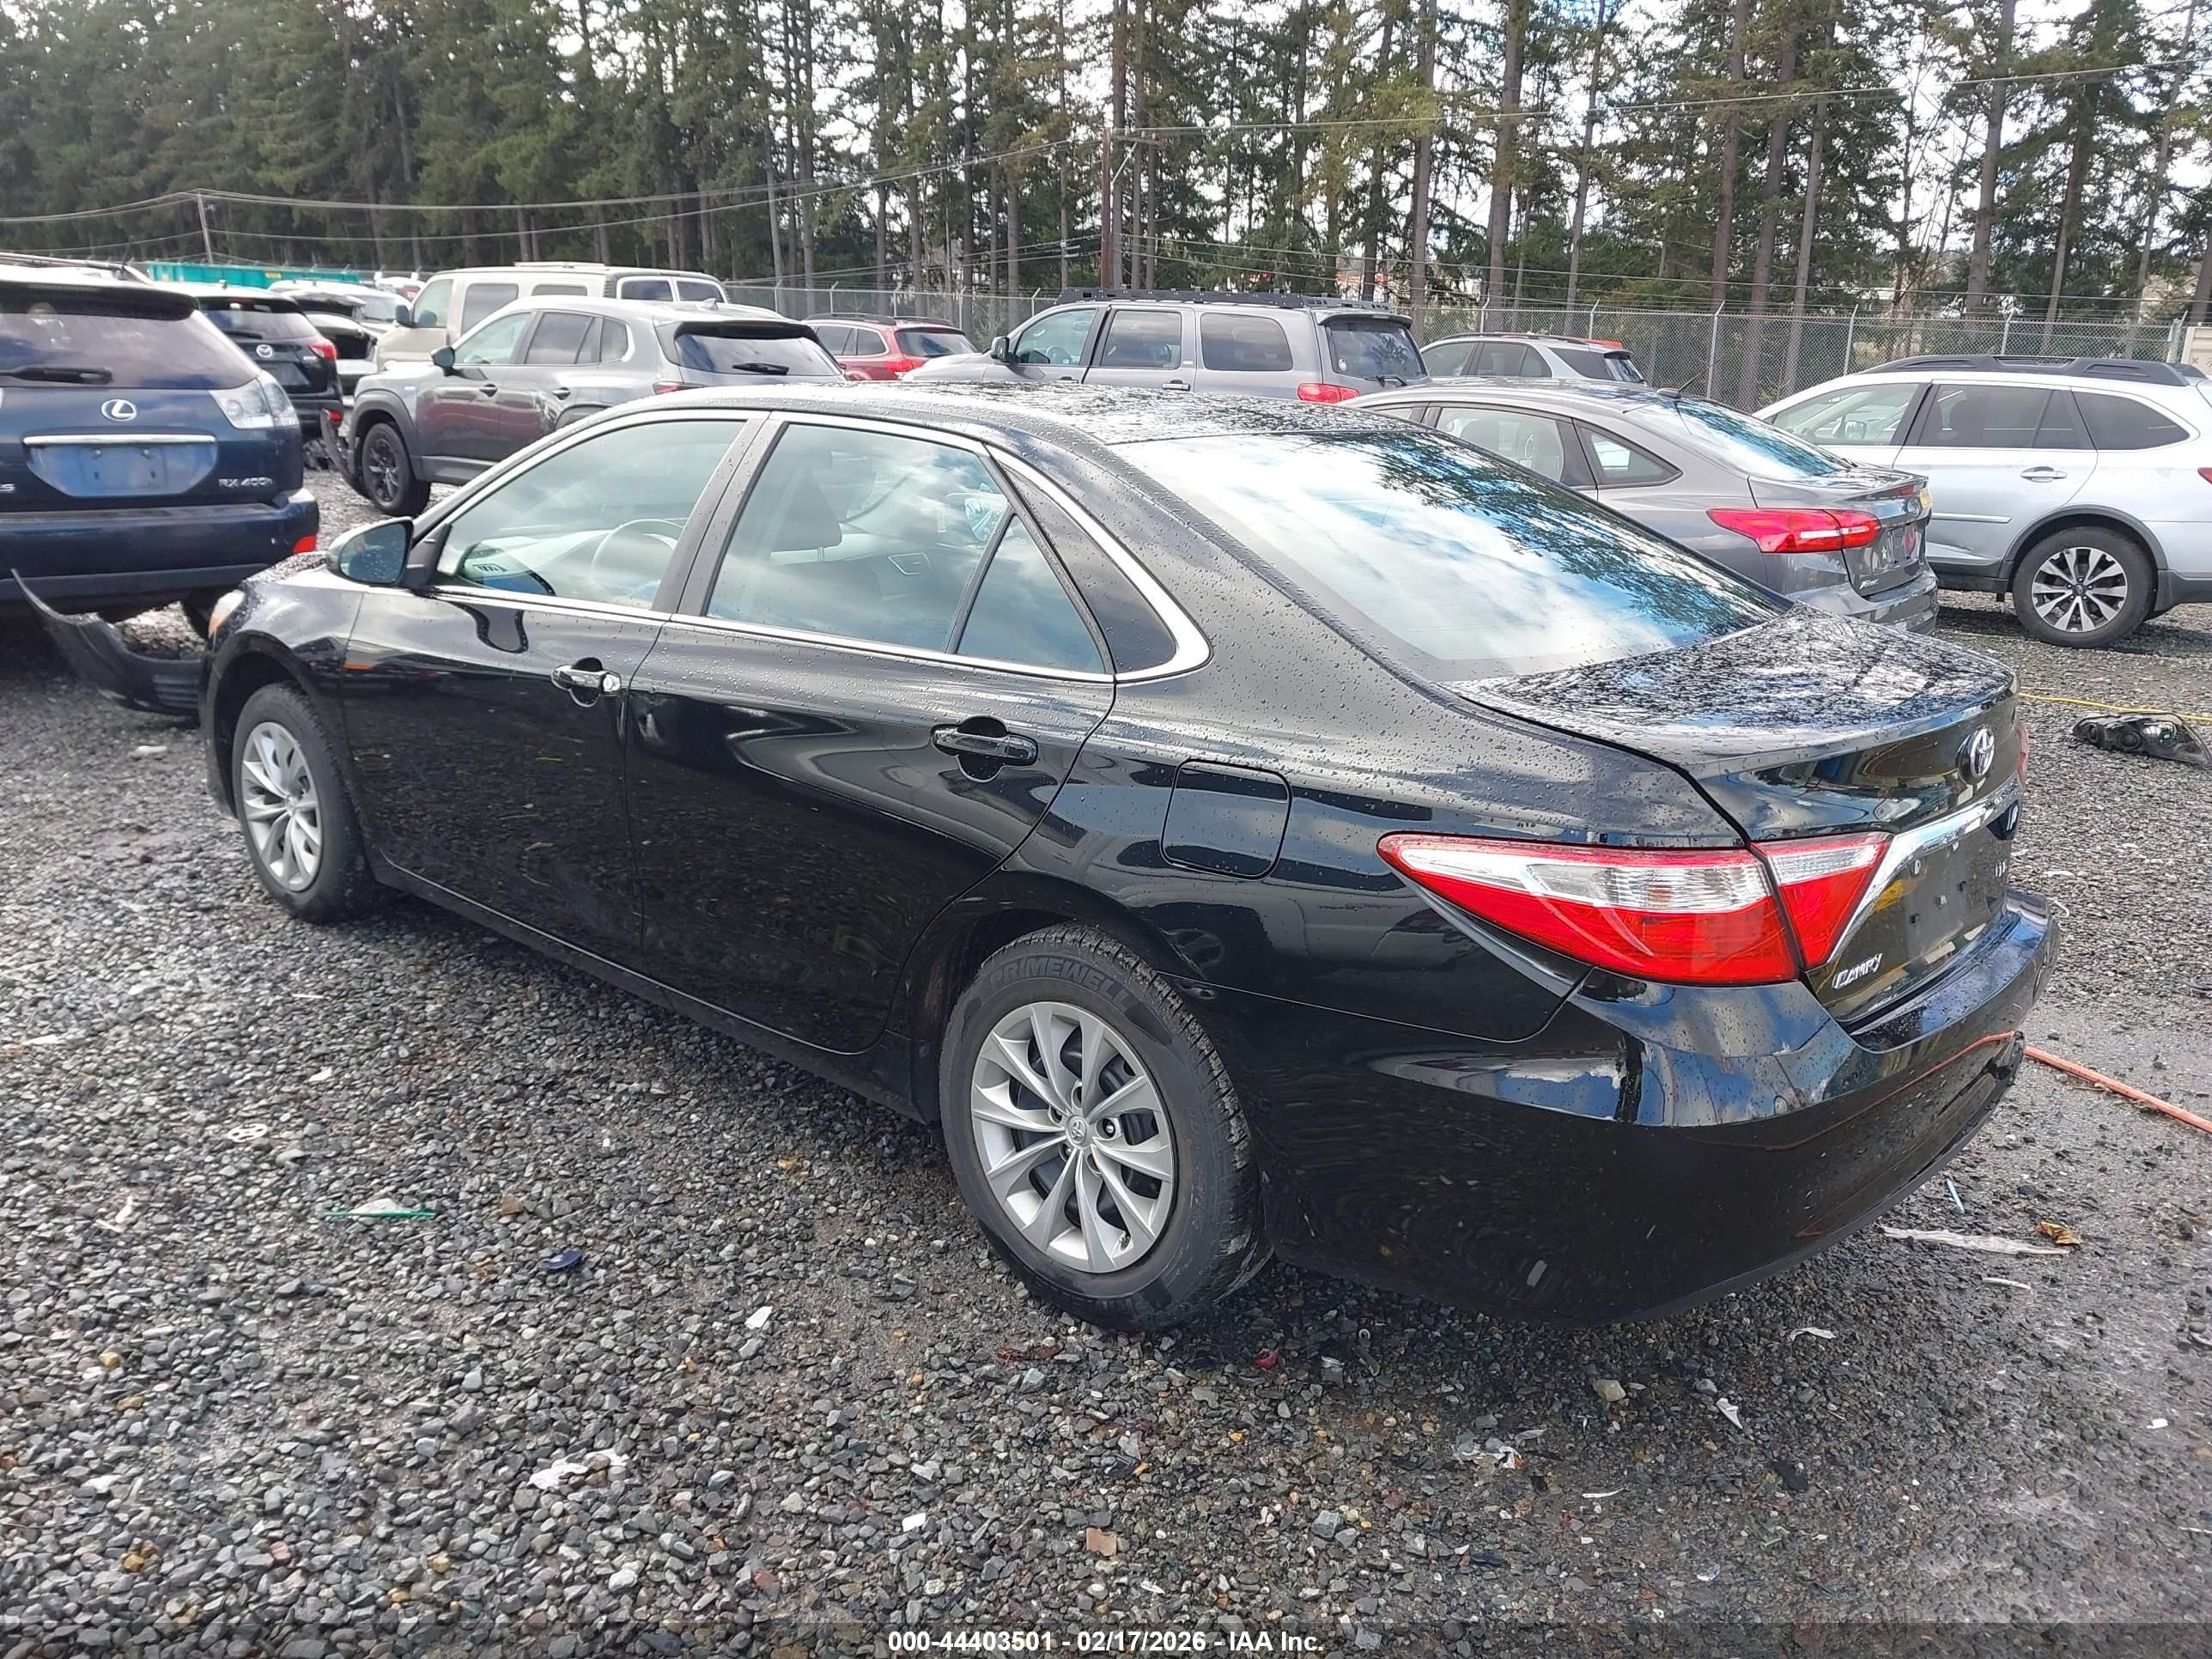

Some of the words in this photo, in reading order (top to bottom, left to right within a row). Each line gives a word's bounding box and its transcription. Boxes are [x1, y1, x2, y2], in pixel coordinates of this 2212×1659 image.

[218, 478, 239, 488] RX
[989, 957, 1131, 1012] PRIMEWELL
[1832, 952, 1883, 989] CAMRY
